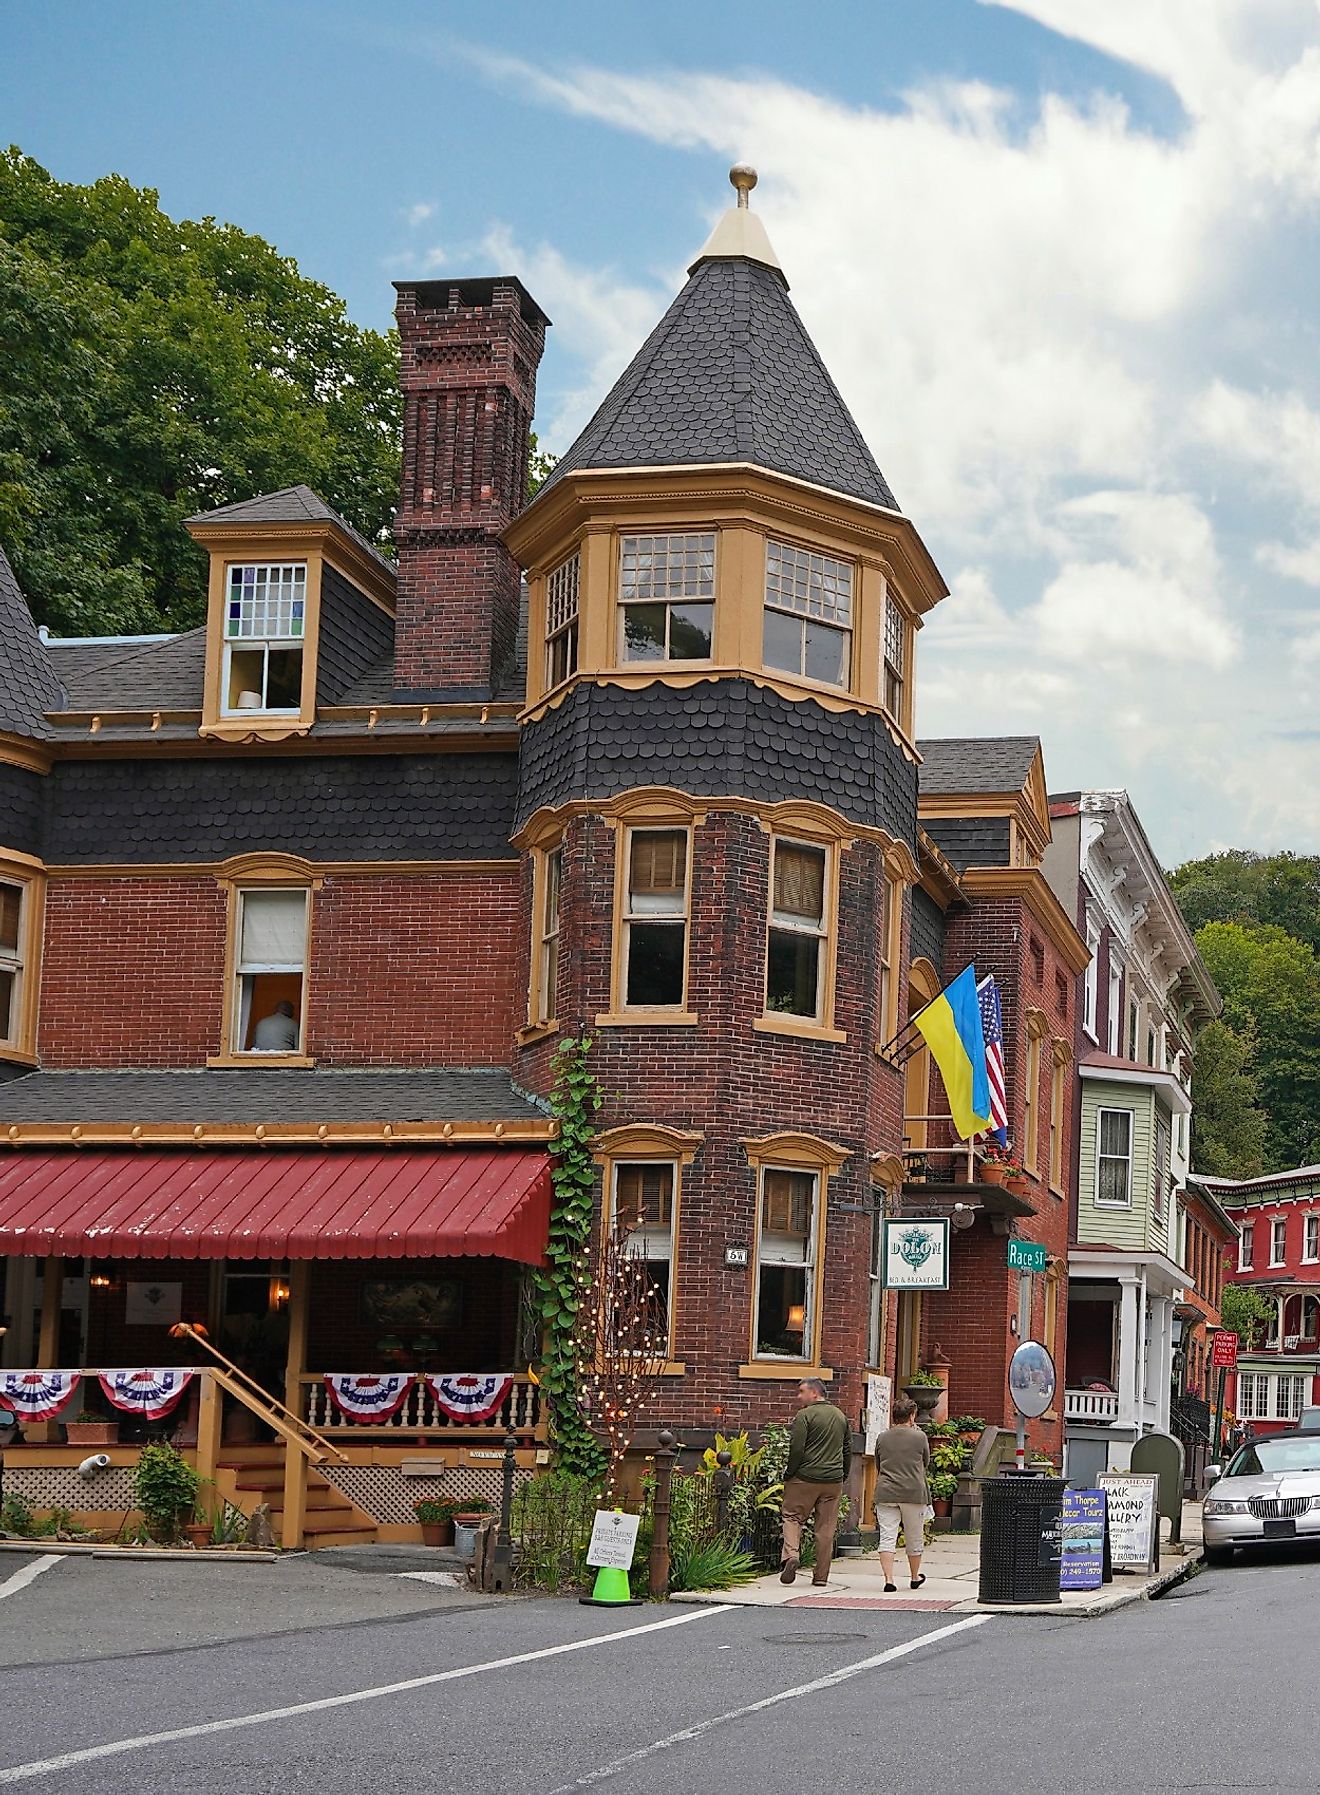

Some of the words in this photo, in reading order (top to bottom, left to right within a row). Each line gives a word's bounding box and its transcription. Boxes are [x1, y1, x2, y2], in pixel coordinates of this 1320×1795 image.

[891, 1241, 941, 1255] DOLON
[1010, 1244, 1033, 1266] Race
[1103, 1486, 1130, 1498] LACK
[1074, 1495, 1099, 1507] Thorpe
[1108, 1500, 1144, 1511] AMOND
[1109, 1512, 1142, 1524] LLERY
